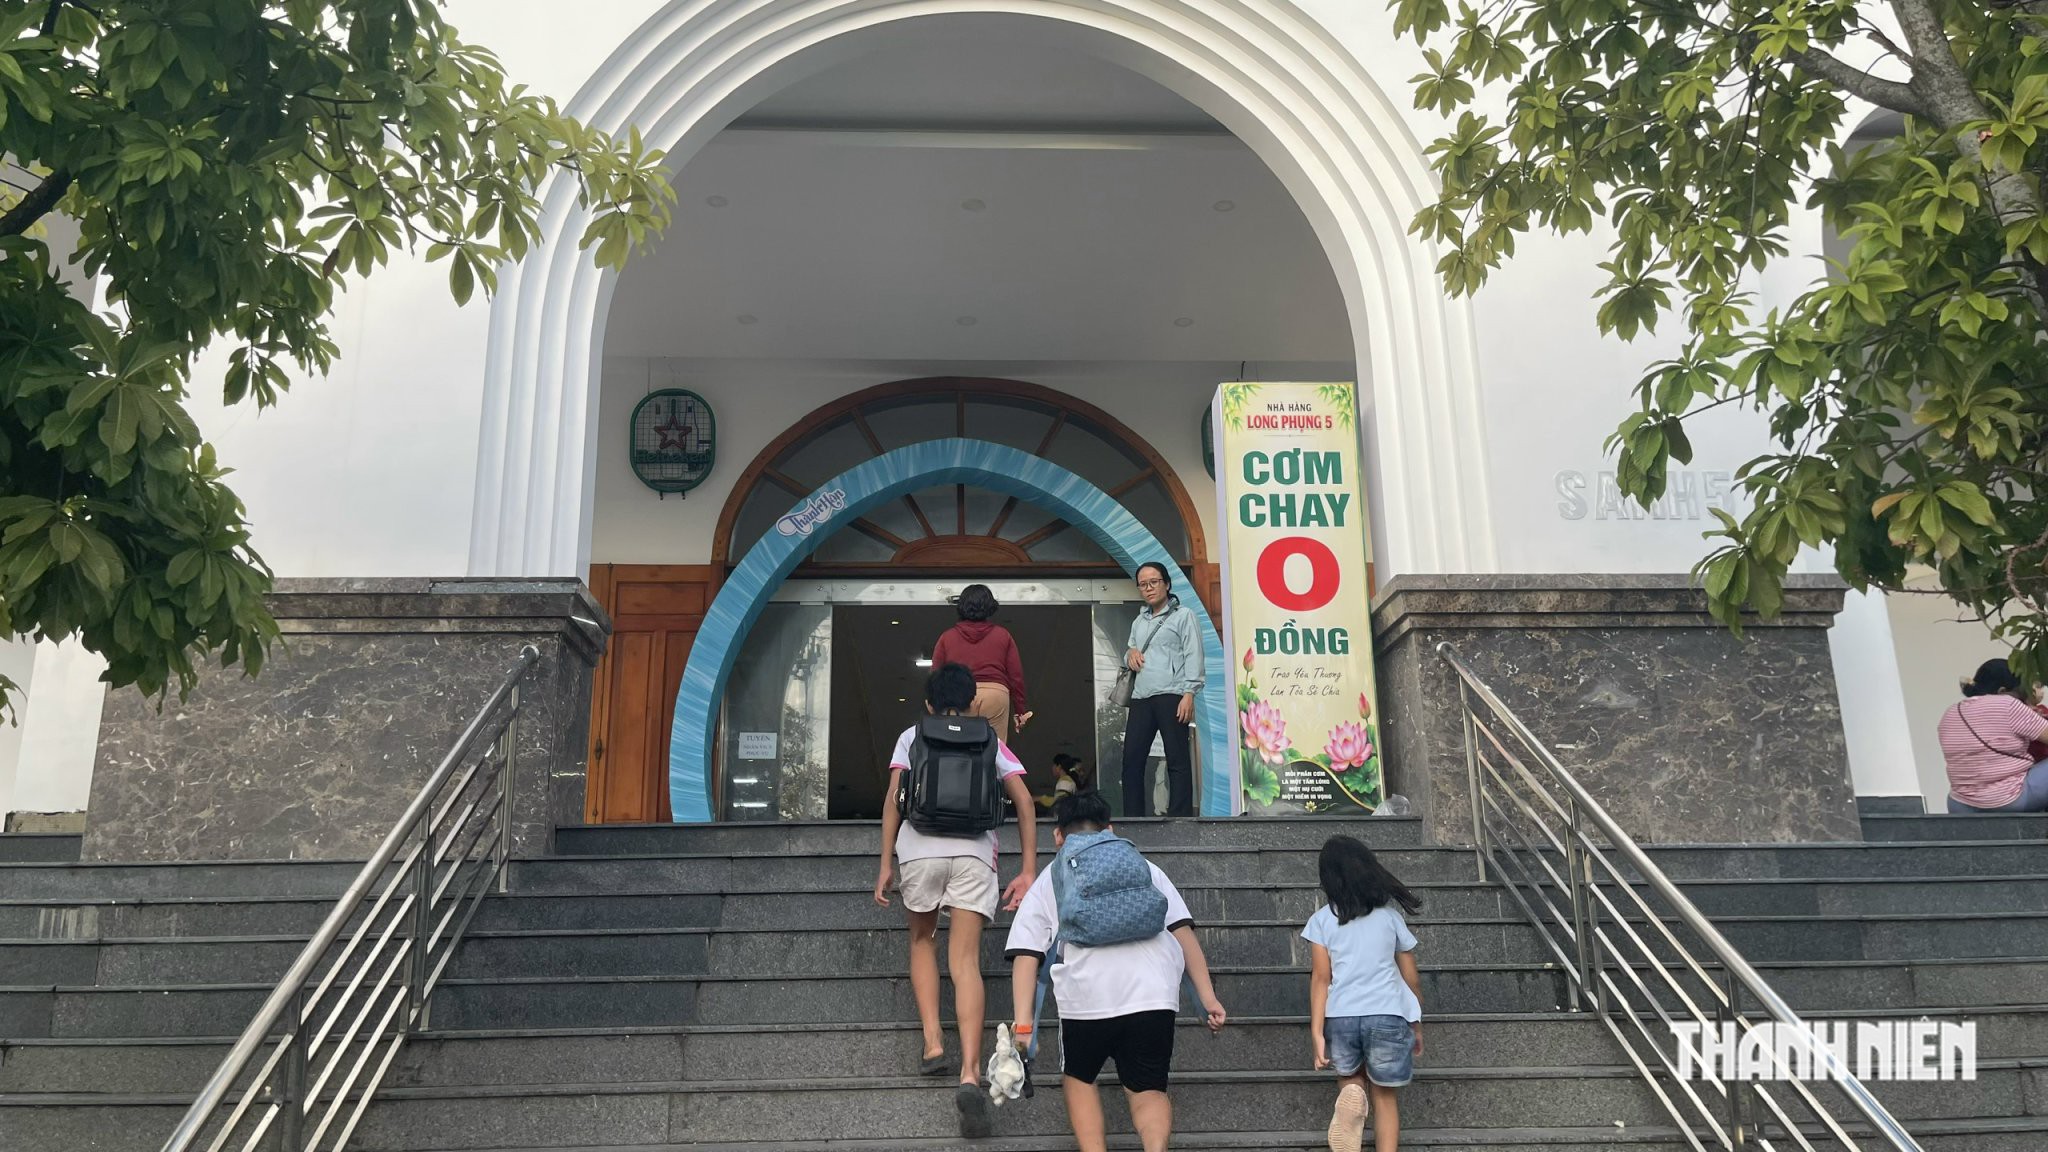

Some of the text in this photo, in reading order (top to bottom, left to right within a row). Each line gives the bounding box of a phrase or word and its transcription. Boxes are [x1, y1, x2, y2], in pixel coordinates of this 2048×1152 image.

[1267, 402, 1312, 412] NHÀ HÀNG
[1247, 415, 1333, 433] LONG PHỤNG 5
[1242, 448, 1343, 486] CƠM
[1239, 493, 1351, 528] CHAY
[1254, 618, 1349, 655] ĐỒNG
[1271, 667, 1290, 679] Trao
[1270, 685, 1284, 696] Lan
[1321, 684, 1340, 697] Chia
